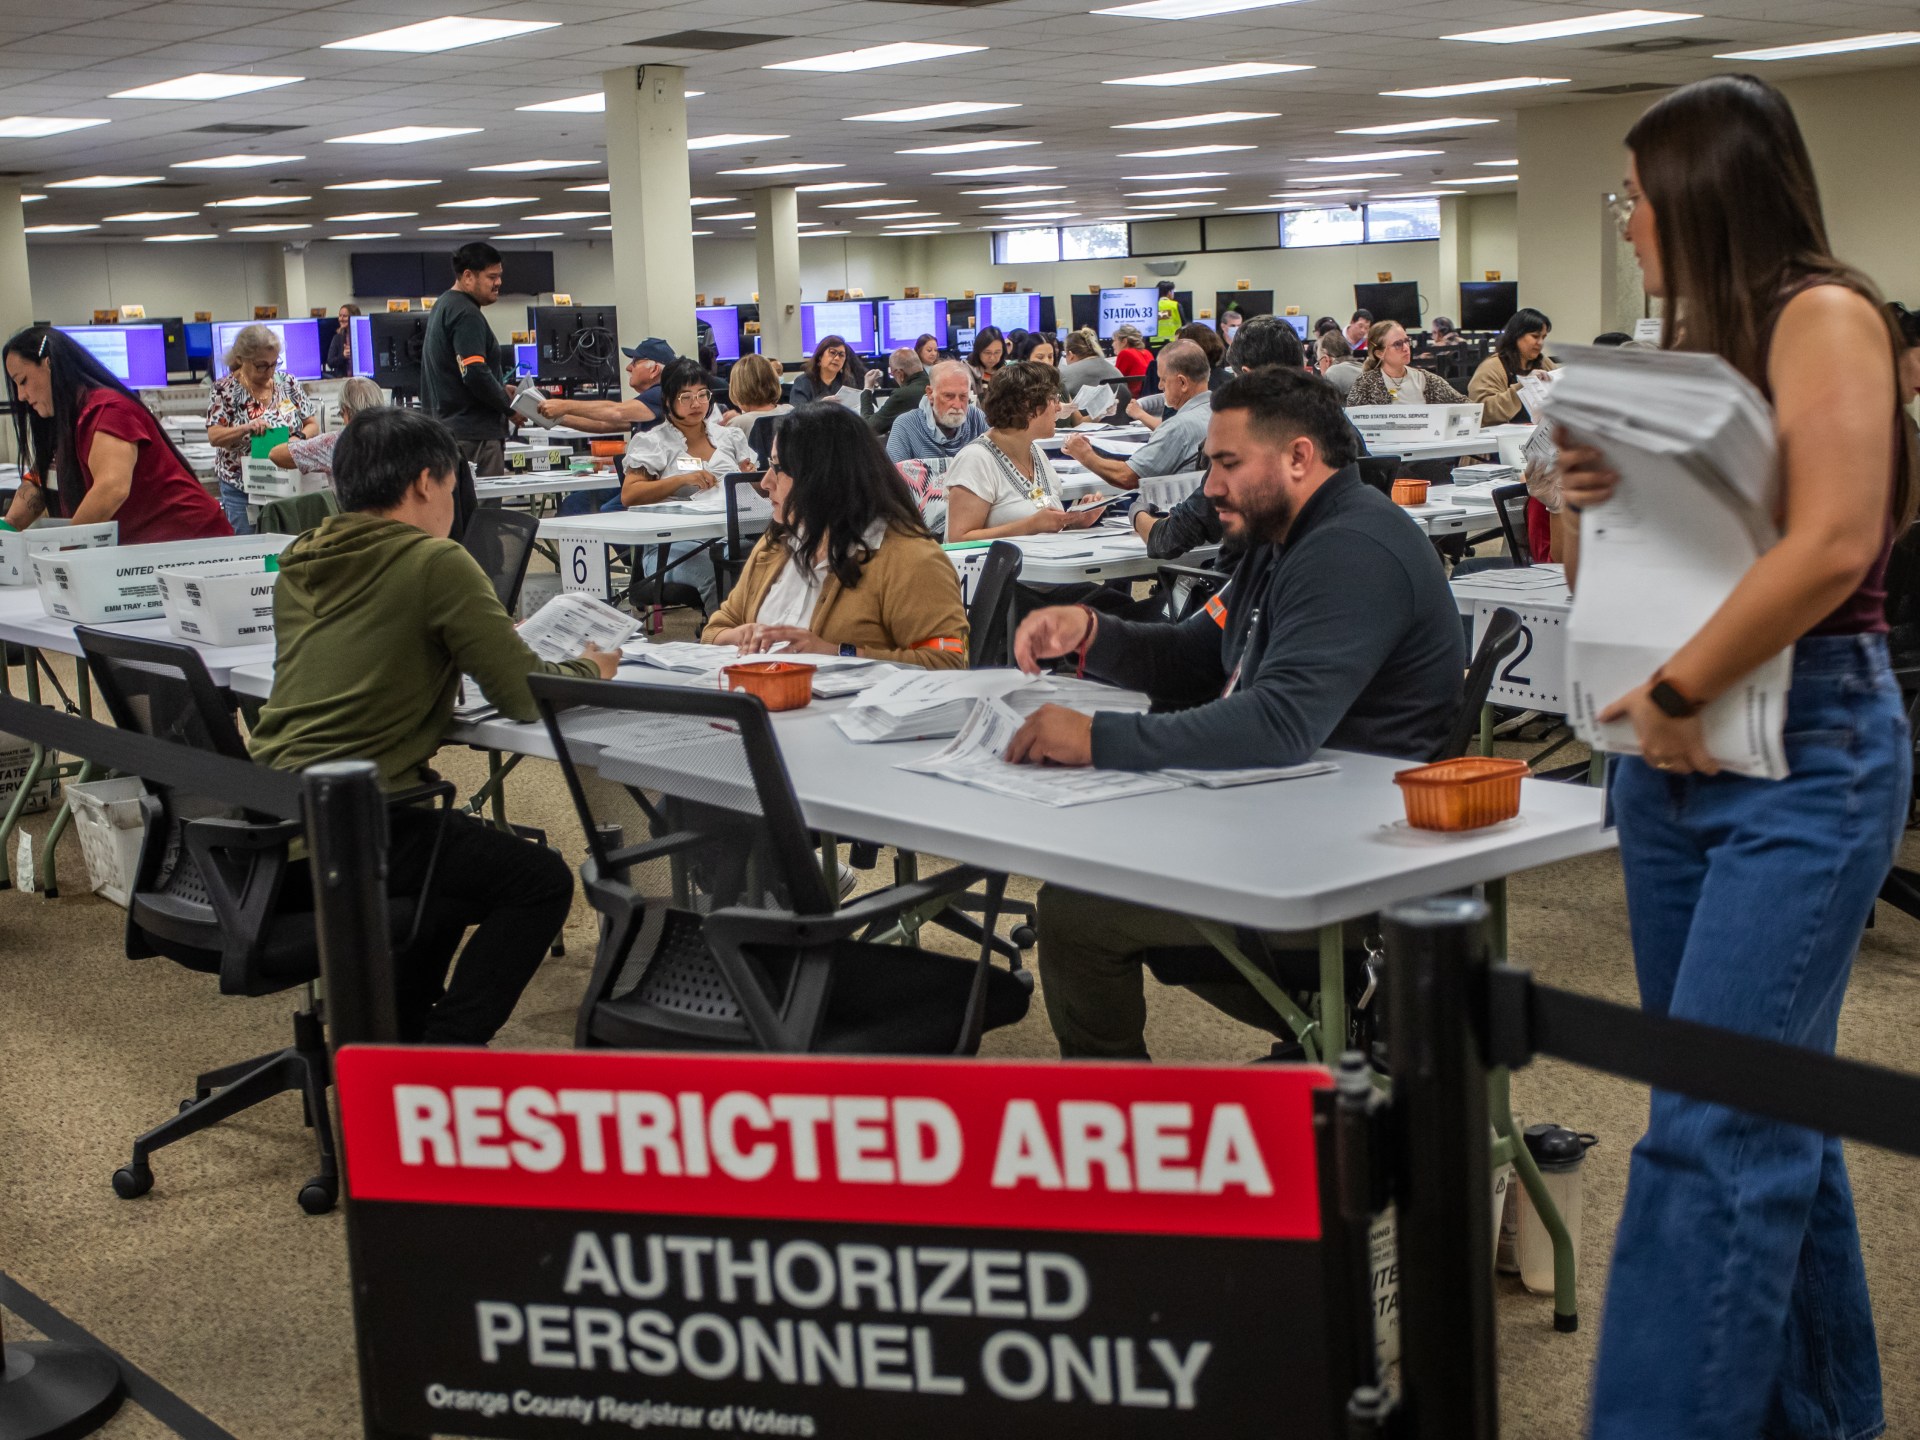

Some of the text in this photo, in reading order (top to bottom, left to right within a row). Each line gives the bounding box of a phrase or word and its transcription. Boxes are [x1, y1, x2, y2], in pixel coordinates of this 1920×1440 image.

[1103, 307, 1153, 320] STATION 33
[116, 565, 155, 577] UNITED
[573, 545, 588, 584] 6
[250, 586, 275, 597] UNIT
[104, 605, 121, 613] EMM
[123, 602, 142, 611] TRAY
[238, 626, 256, 635] EMM
[1500, 624, 1534, 686] 2
[0, 767, 28, 780] TATE
[393, 1084, 1274, 1197] RESTRICTED AREA
[563, 1230, 1090, 1322] AUTHORIZED
[475, 1301, 1213, 1410] PERSONNEL ONLY
[426, 1382, 816, 1437] Orange County Registrar of Voters
